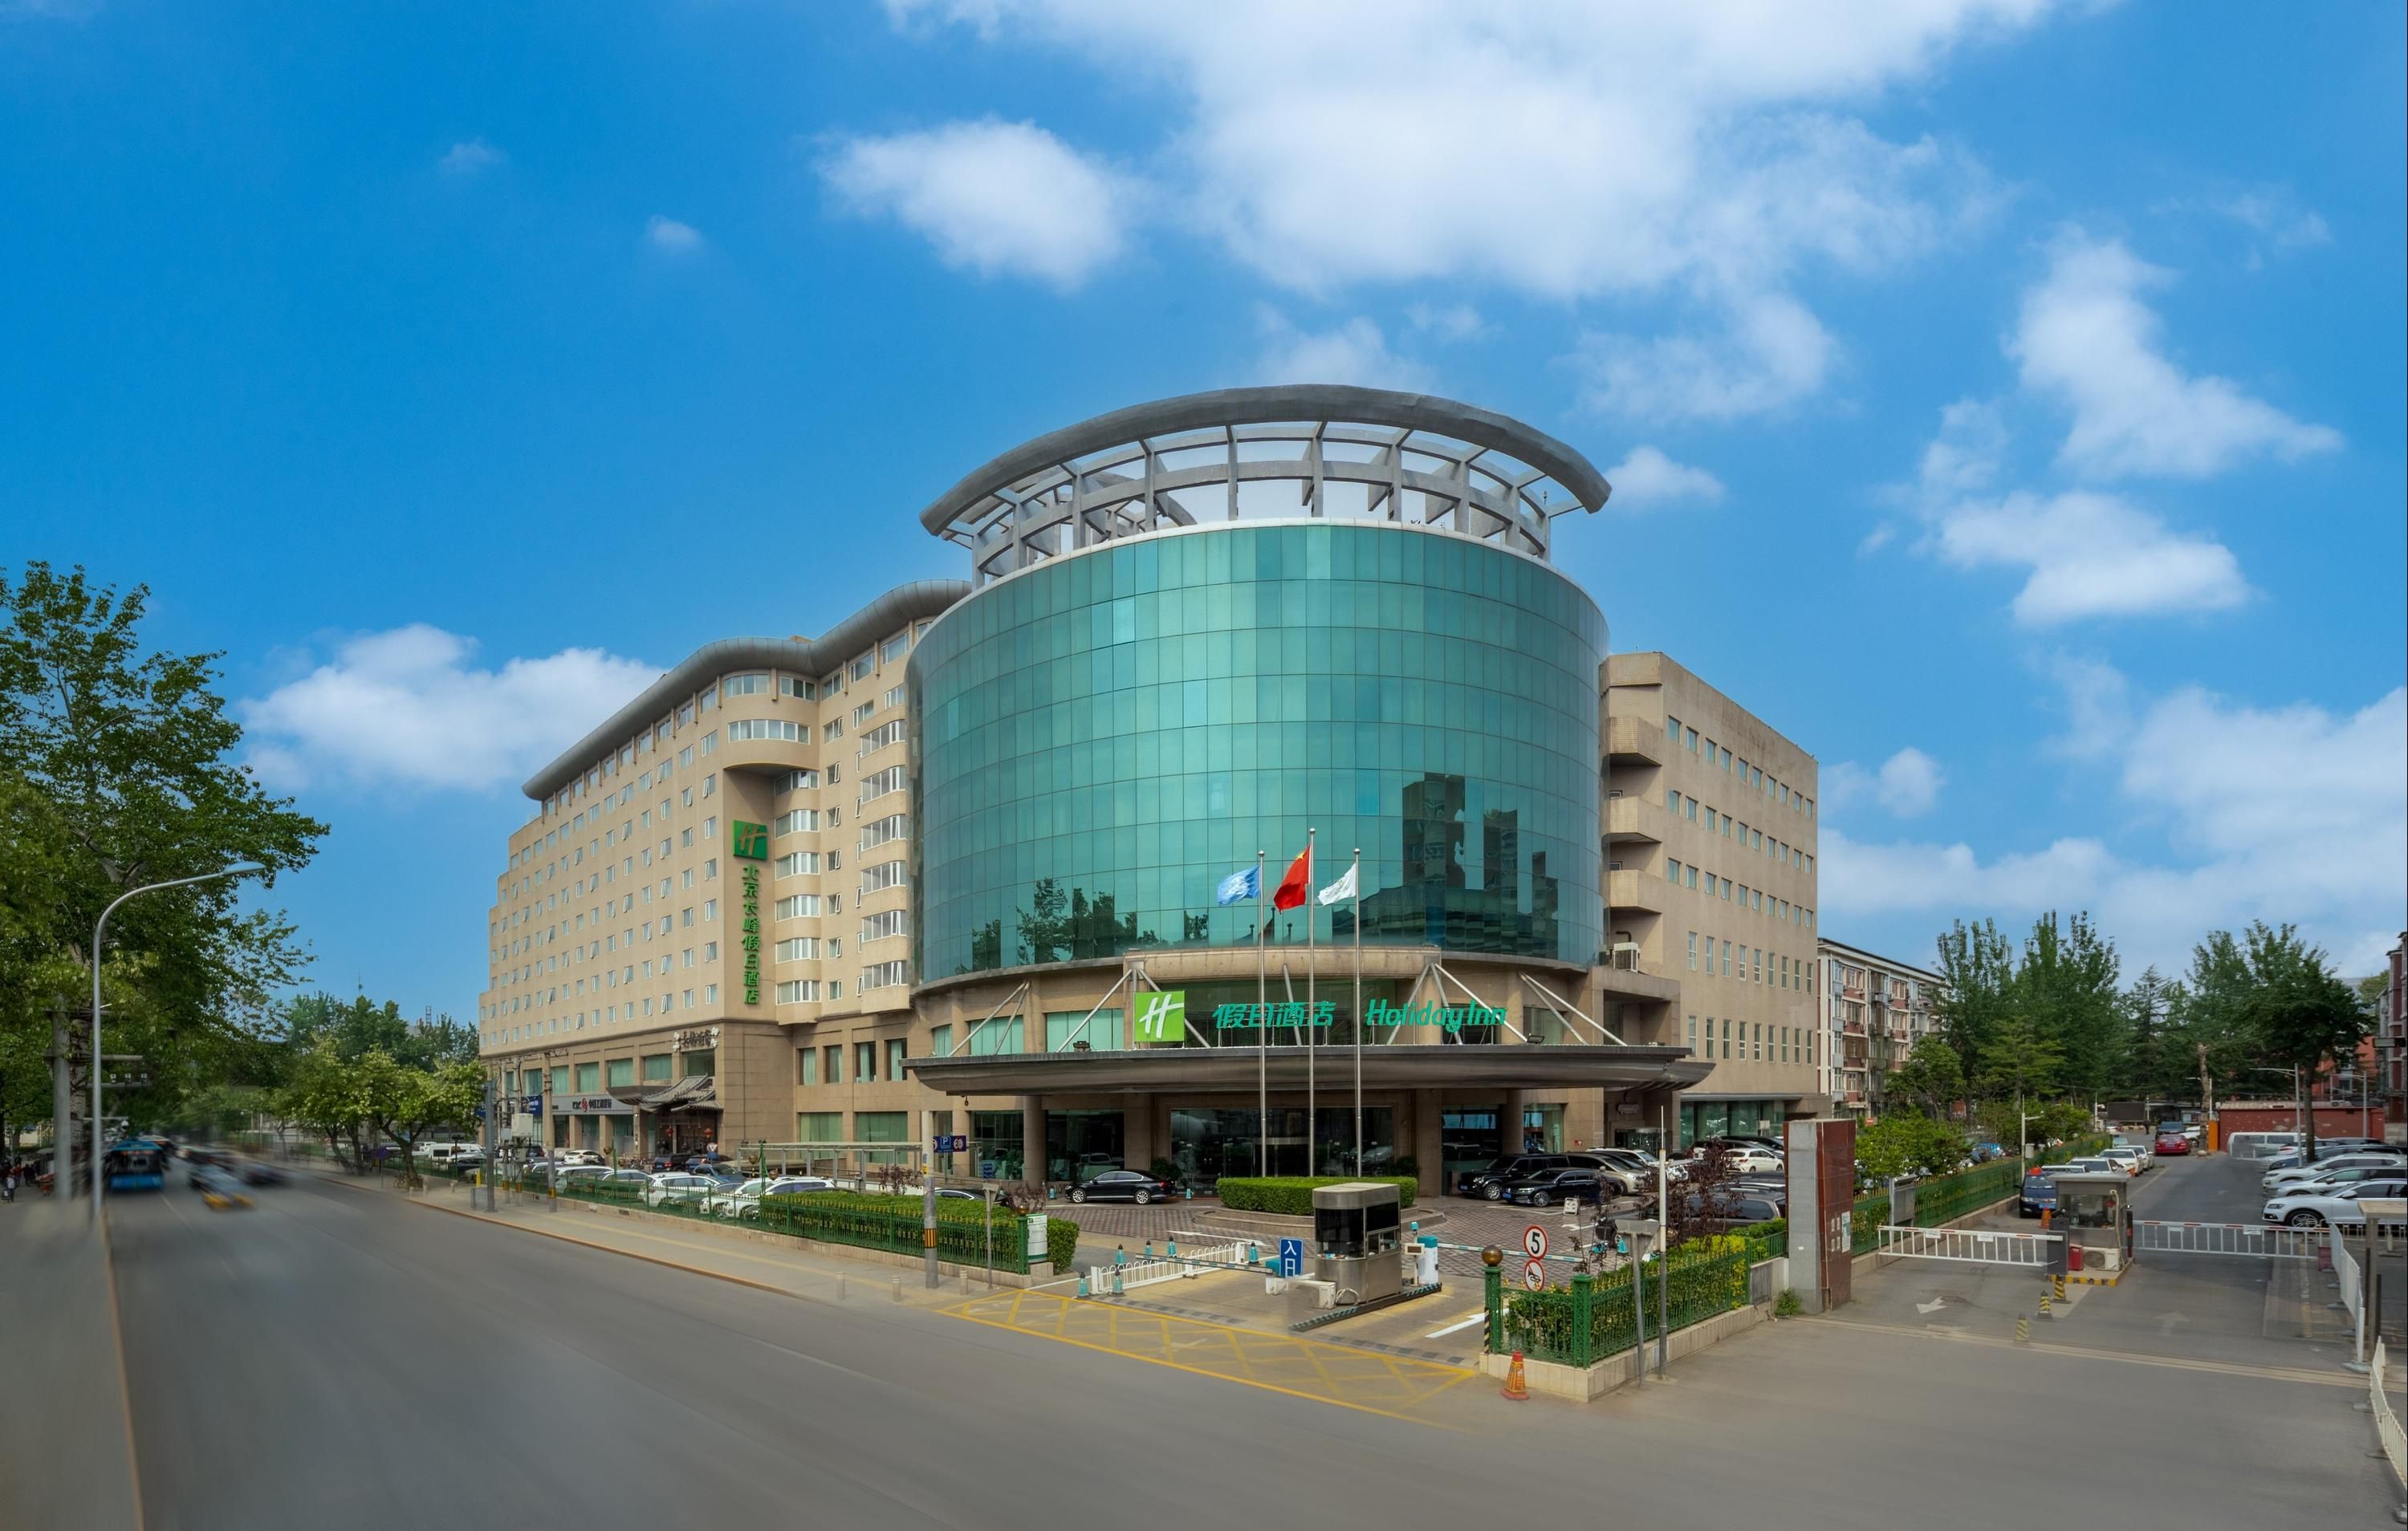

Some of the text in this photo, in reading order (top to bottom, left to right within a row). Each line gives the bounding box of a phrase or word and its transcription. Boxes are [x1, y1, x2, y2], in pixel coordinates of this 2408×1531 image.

[742, 863, 761, 1005] 北京长峰假日酒店
[1212, 1001, 1336, 1029] 假日酒店
[1531, 1231, 1540, 1254] 5
